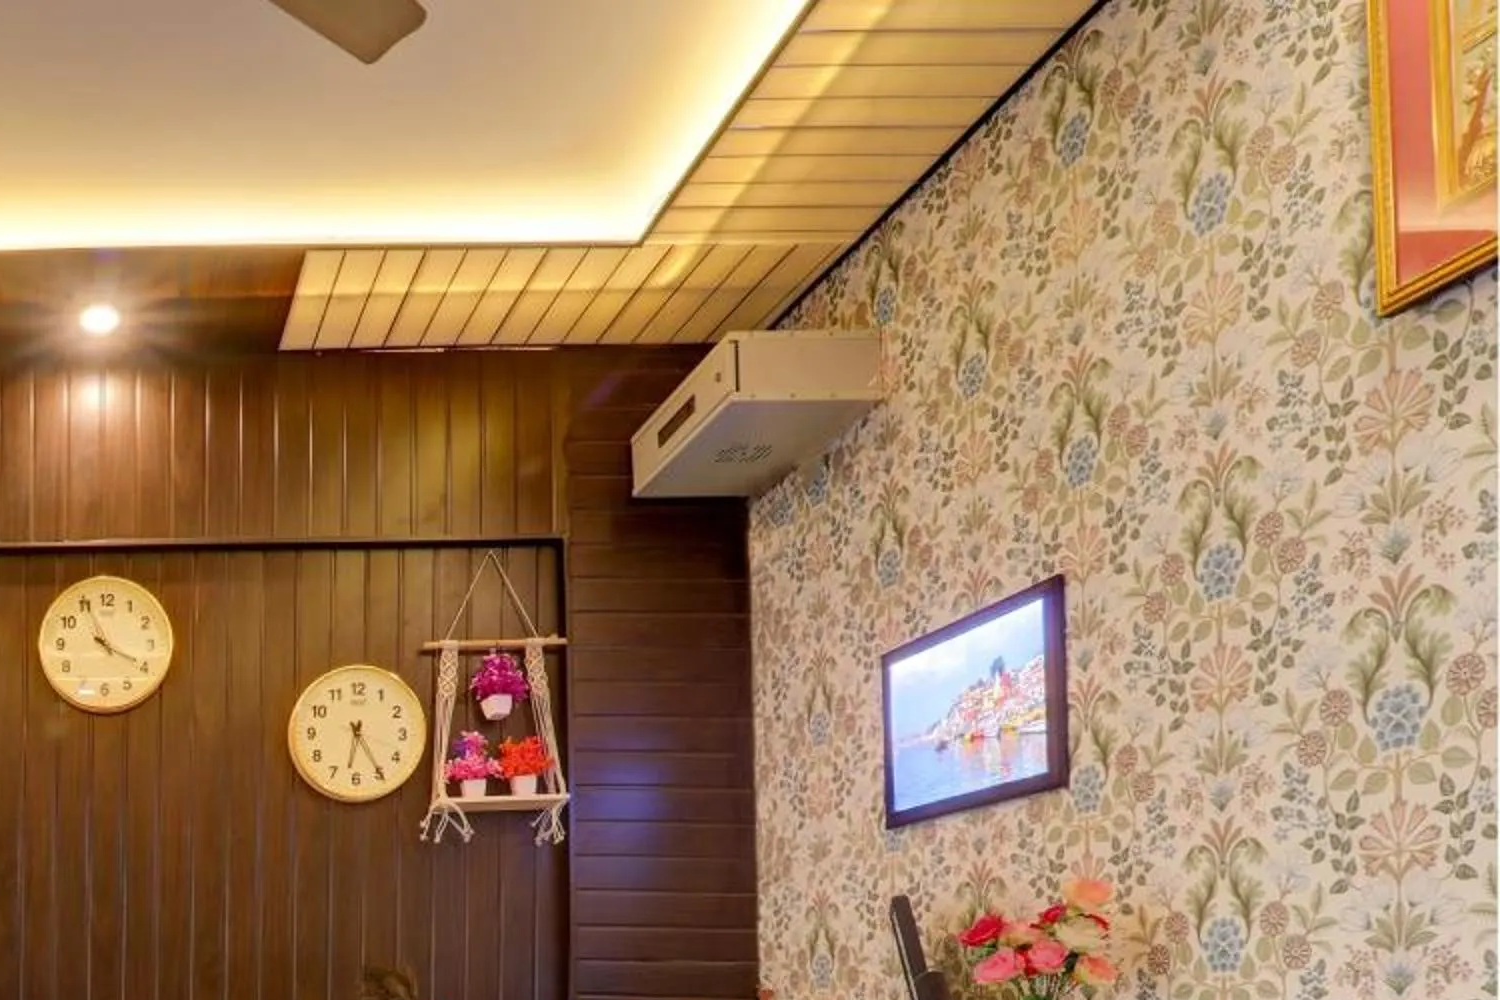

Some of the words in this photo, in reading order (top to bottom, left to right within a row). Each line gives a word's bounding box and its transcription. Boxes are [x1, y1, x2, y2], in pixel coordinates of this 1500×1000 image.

[100, 594, 114, 607] 12
[127, 600, 132, 612] 1
[61, 616, 76, 628] 10
[141, 616, 150, 629] 2
[56, 638, 64, 650] 9
[62, 660, 70, 672] 8
[140, 662, 148, 673] 4
[101, 683, 109, 696] 6
[329, 690, 341, 701] 11
[352, 683, 365, 696] 12
[378, 689, 384, 700] 1
[313, 706, 326, 718] 10
[392, 706, 401, 718] 2
[308, 728, 316, 740] 9
[398, 728, 407, 740] 3
[312, 750, 321, 762] 8
[392, 752, 400, 763] 4
[329, 766, 338, 779] 7
[374, 767, 384, 780] 5
[352, 773, 360, 785] 6
